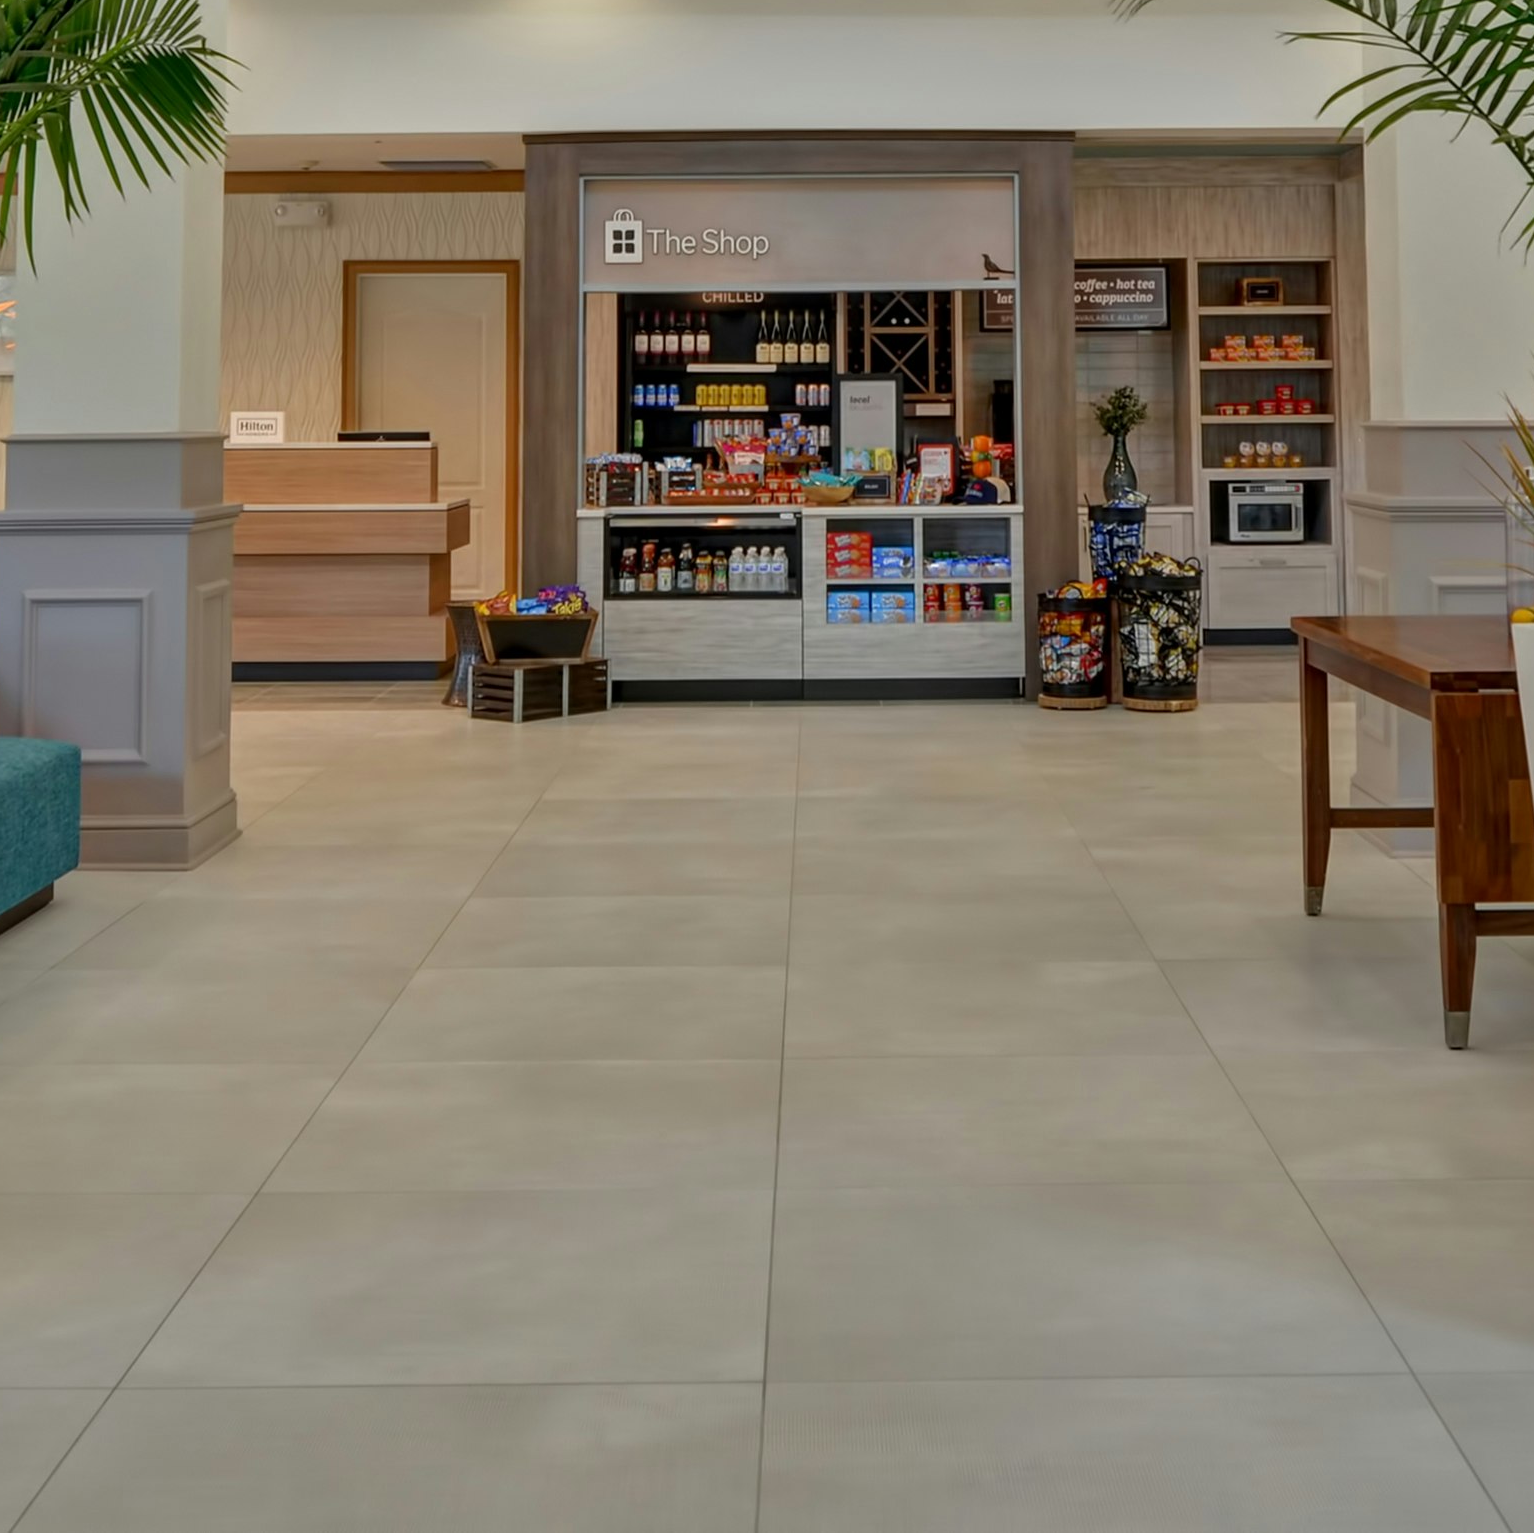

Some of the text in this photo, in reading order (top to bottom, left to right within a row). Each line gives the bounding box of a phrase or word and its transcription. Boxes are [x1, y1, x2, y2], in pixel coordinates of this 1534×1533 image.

[646, 228, 769, 260] The Shop
[1074, 278, 1155, 293] coffee hot tea
[702, 292, 764, 303] CHILLED
[997, 293, 1013, 304] lat
[1089, 291, 1154, 306] cappuccino
[240, 421, 274, 431] Hilton
